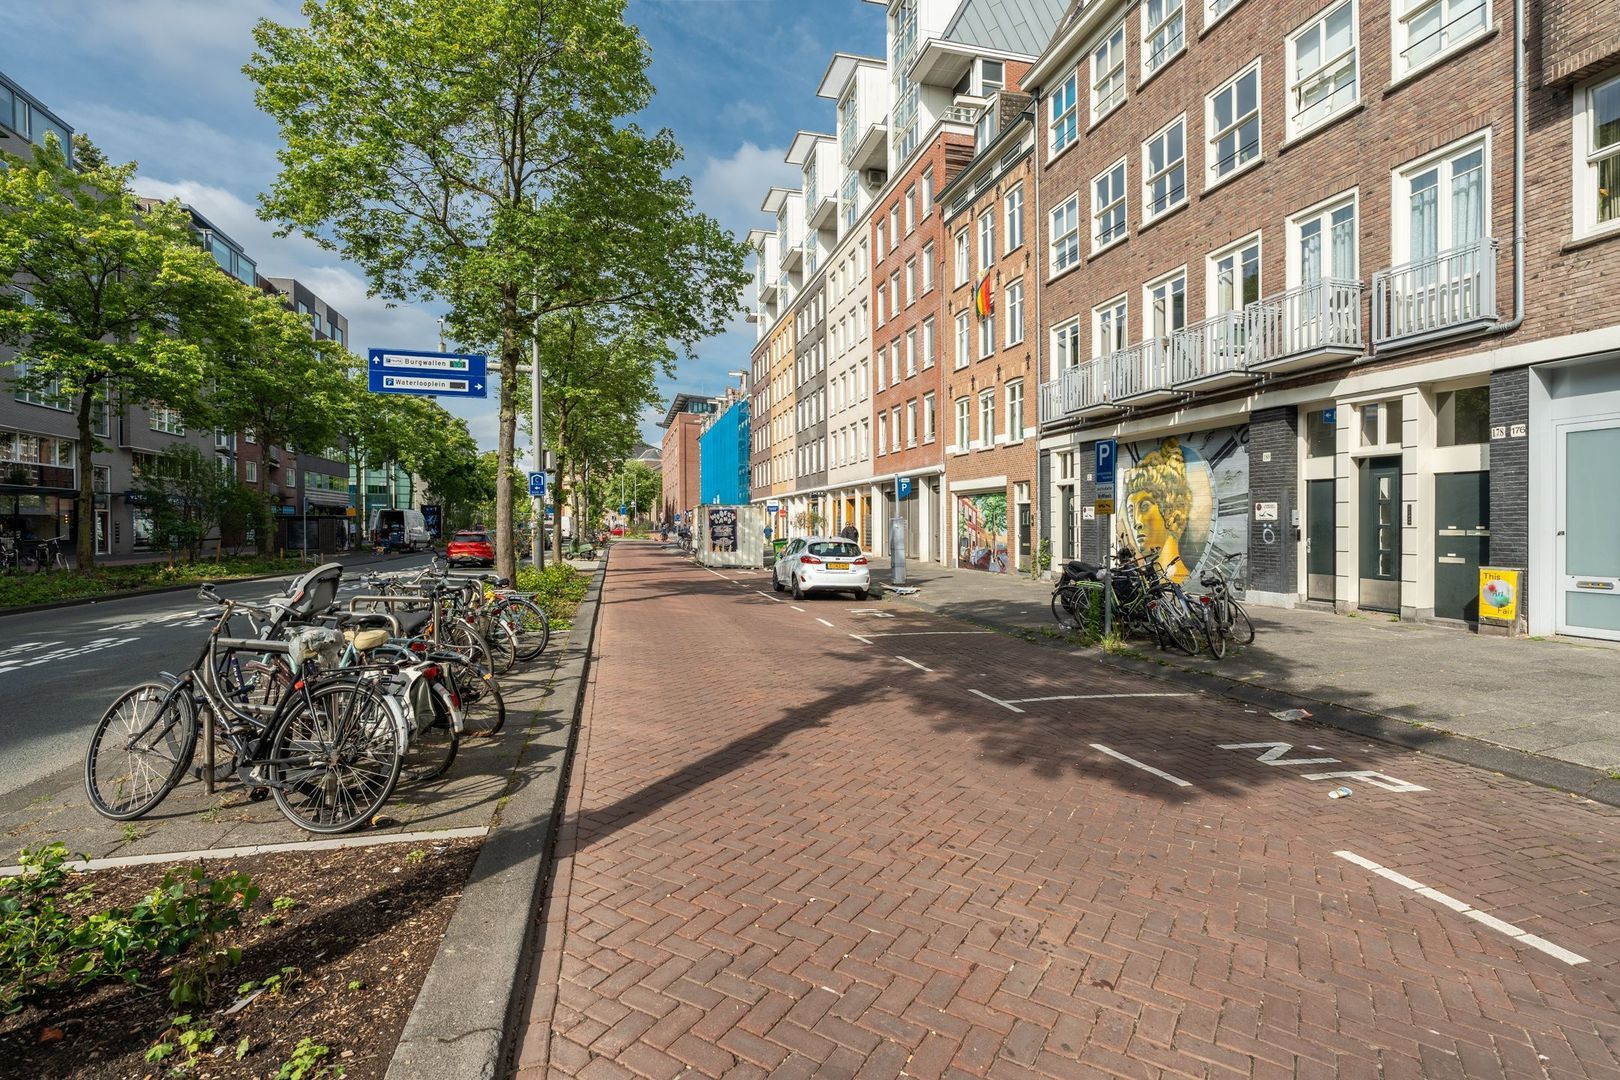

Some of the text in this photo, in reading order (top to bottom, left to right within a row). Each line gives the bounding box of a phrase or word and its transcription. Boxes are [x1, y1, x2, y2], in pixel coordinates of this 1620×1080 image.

[404, 358, 447, 367] Burgwallen
[395, 379, 446, 388] Waterlooplein
[1492, 427, 1505, 438] 178
[1099, 444, 1110, 466] P
[901, 483, 908, 492] P
[714, 517, 732, 525] LAND
[1483, 573, 1501, 581] This
[1497, 607, 1513, 615] Fair
